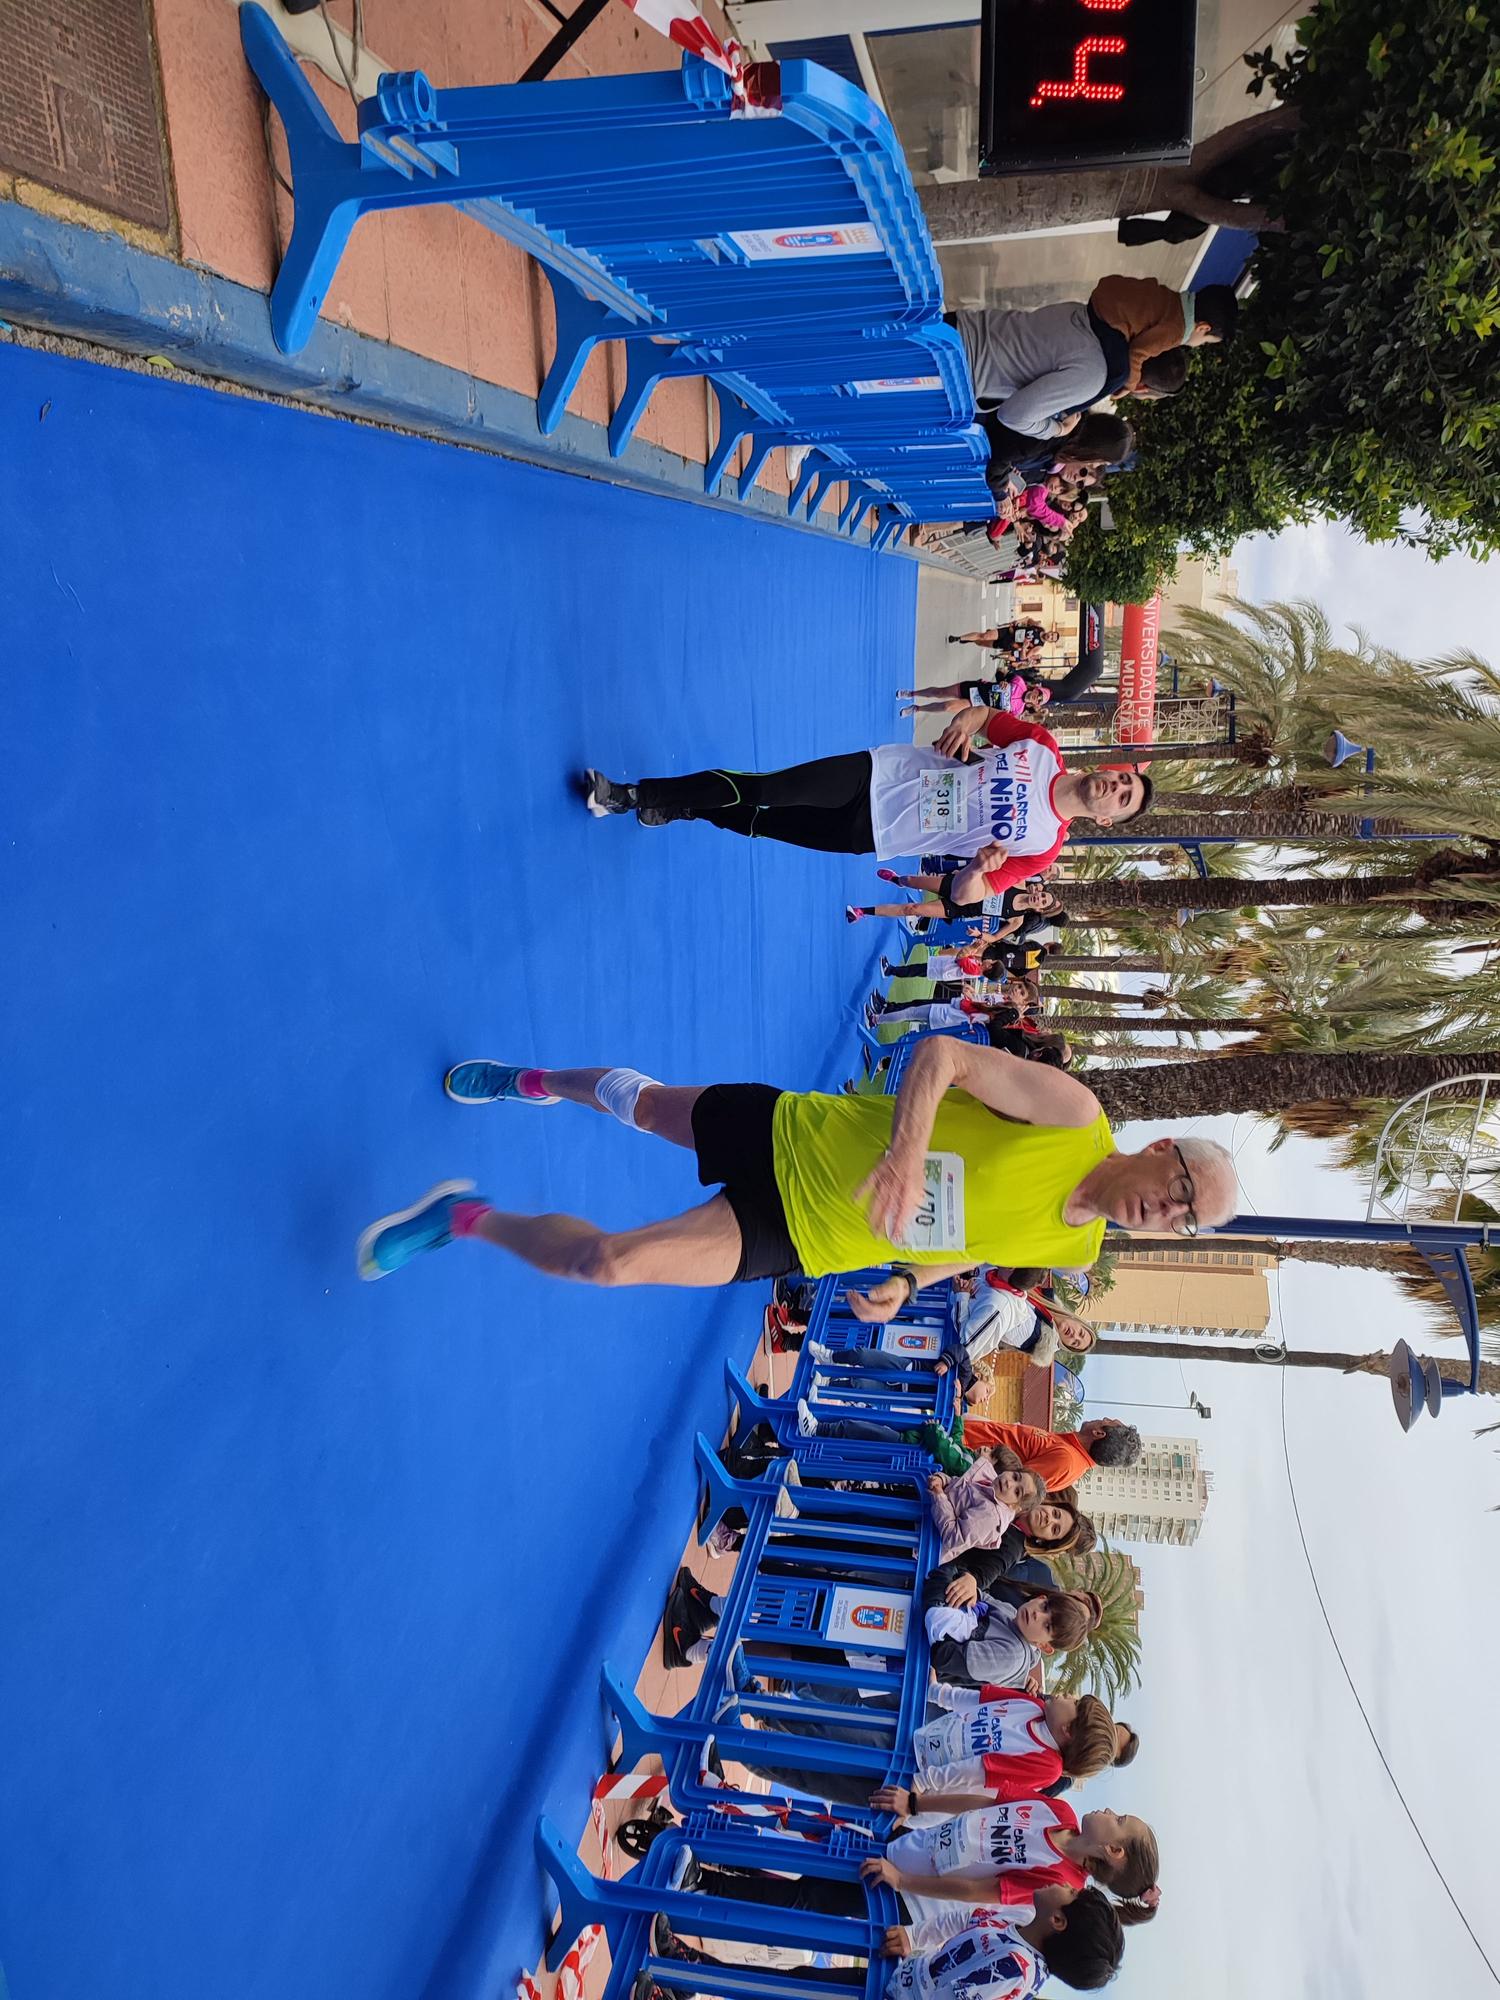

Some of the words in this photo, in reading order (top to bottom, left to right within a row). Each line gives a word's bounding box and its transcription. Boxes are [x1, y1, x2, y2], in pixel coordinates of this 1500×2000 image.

[1139, 598, 1157, 699] NIVERSIDAD
[1138, 706, 1151, 728] DE
[994, 752, 1009, 774] DEL
[937, 789, 950, 816] 318
[1014, 783, 1028, 842] CARRERA
[939, 1823, 952, 1850] 602
